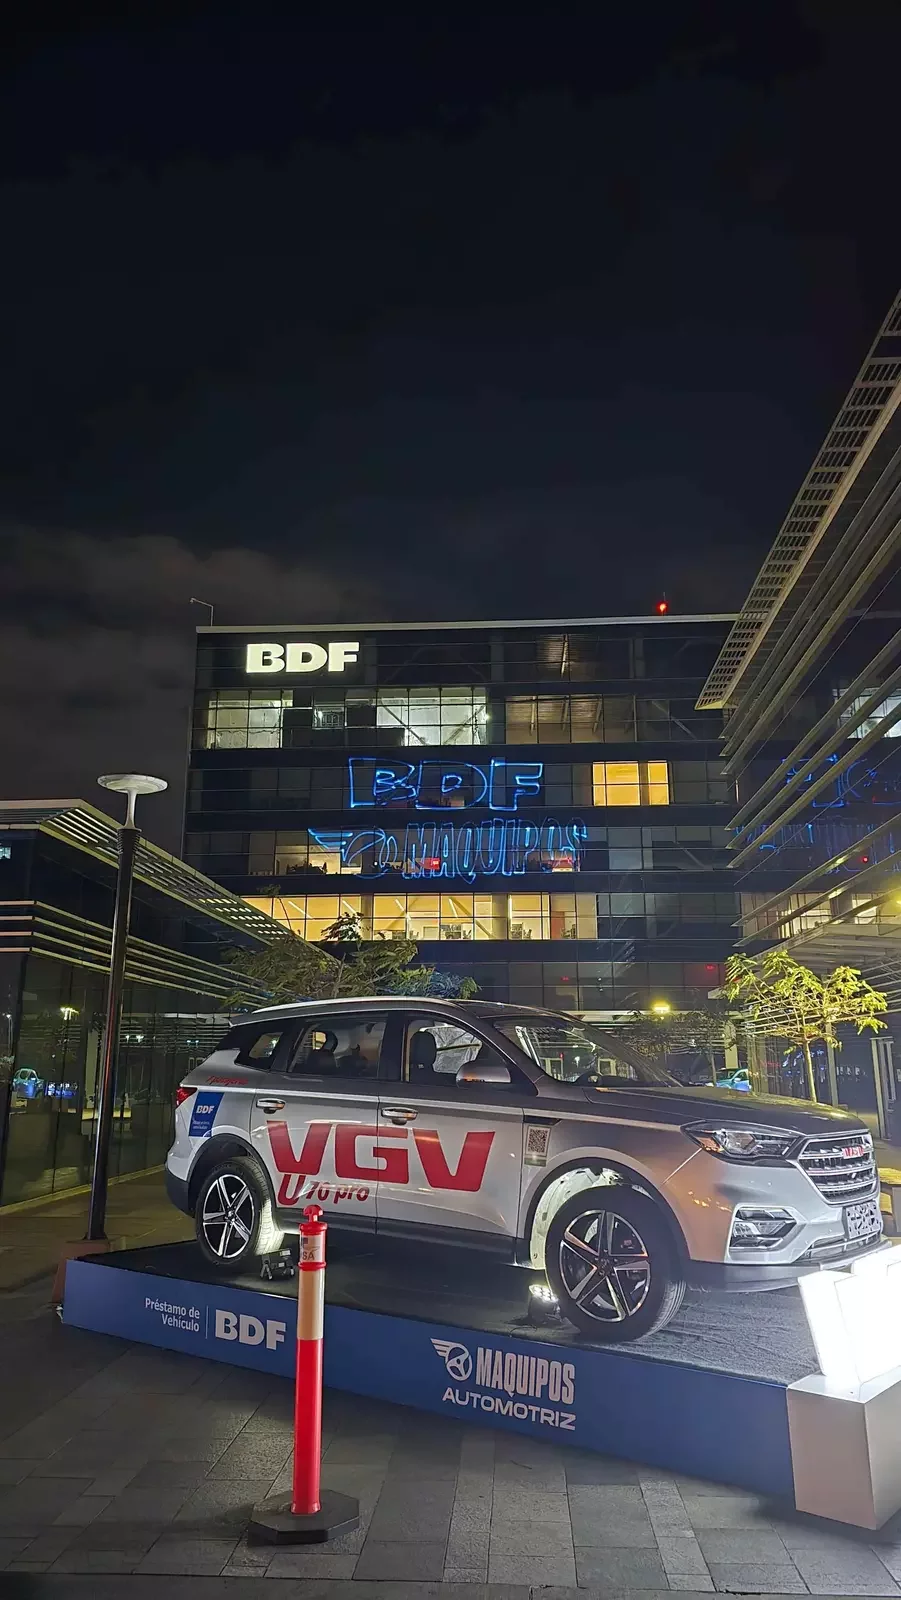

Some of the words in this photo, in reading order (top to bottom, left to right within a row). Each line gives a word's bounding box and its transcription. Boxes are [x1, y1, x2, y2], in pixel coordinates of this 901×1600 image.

[246, 642, 360, 673] BDF
[348, 757, 543, 811] BDF
[402, 817, 588, 884] MAQUIPOS
[196, 1105, 215, 1114] BDF
[266, 1120, 496, 1192] VGV
[333, 1184, 370, 1205] pro
[145, 1297, 187, 1317] Préstamo
[188, 1306, 200, 1319] de
[161, 1313, 200, 1332] Vehículo
[215, 1309, 286, 1351] BDF
[475, 1346, 575, 1405] MAQUIPOS
[441, 1386, 576, 1431] AUTOMOTRIZ
